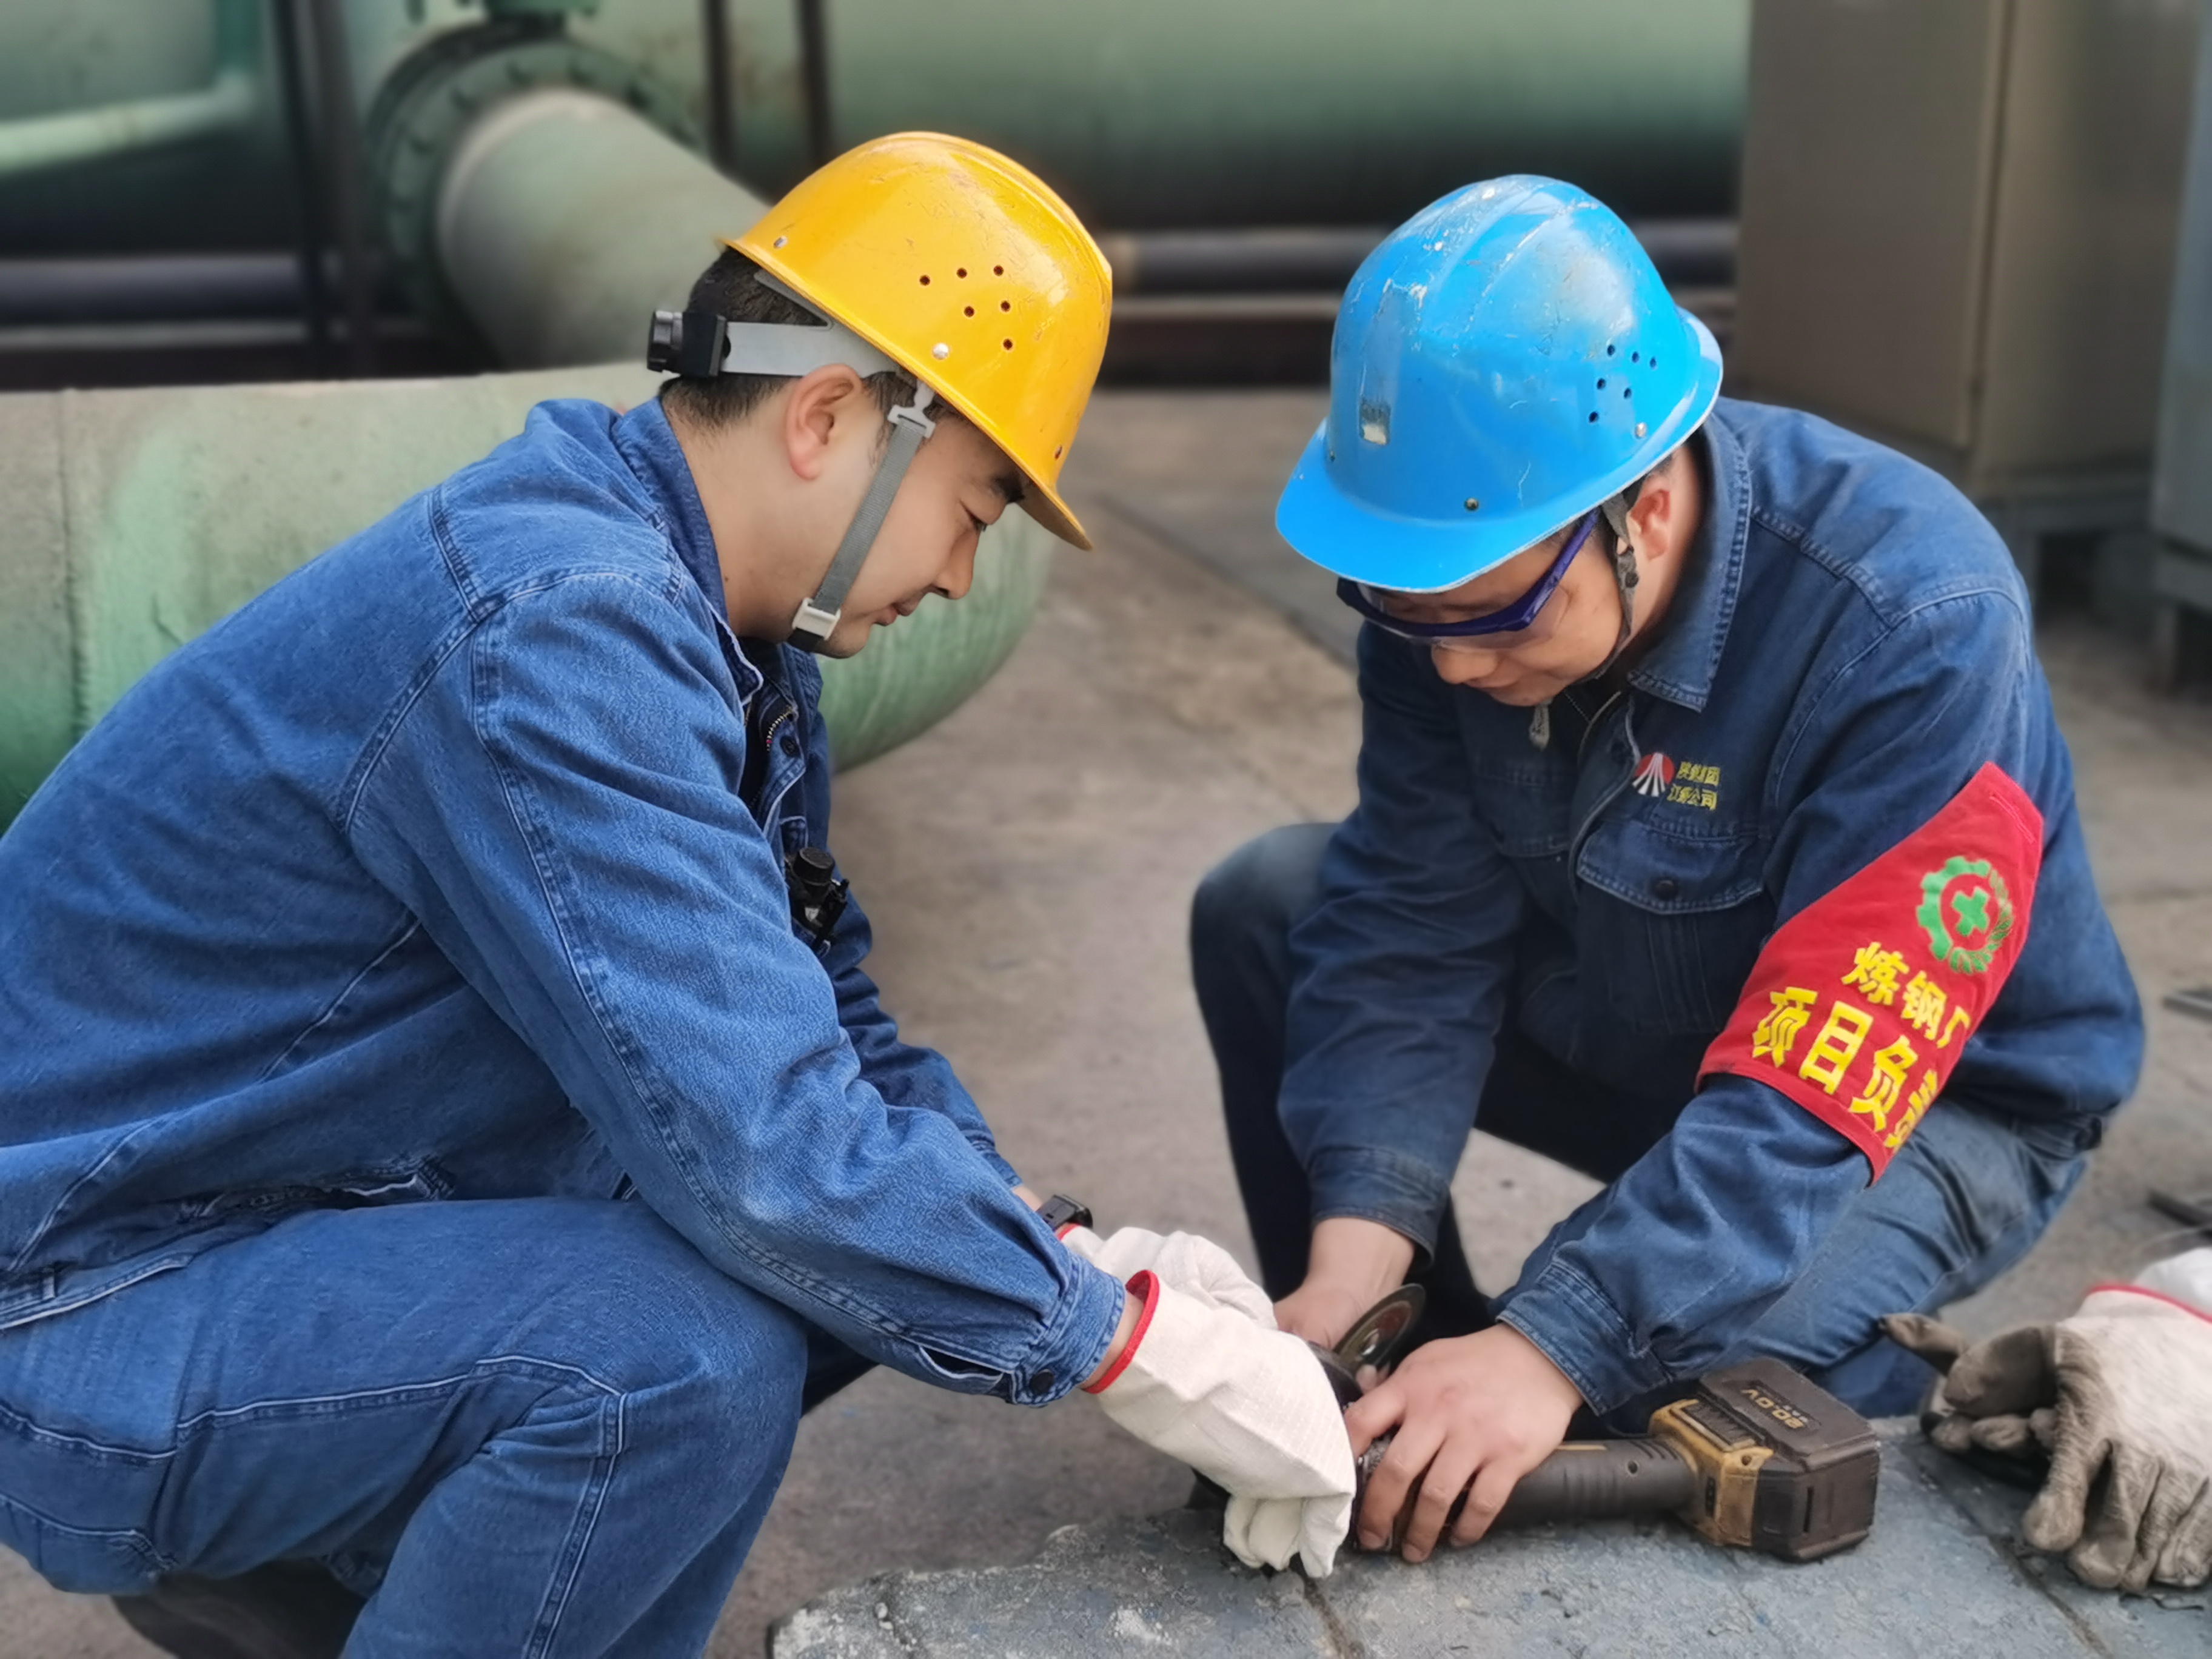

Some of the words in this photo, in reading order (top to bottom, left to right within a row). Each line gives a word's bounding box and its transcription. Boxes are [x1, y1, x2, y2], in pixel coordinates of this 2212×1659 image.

[1841, 941, 1971, 1049] 炼钢厂
[1740, 1389, 1804, 1429] 20.0V
